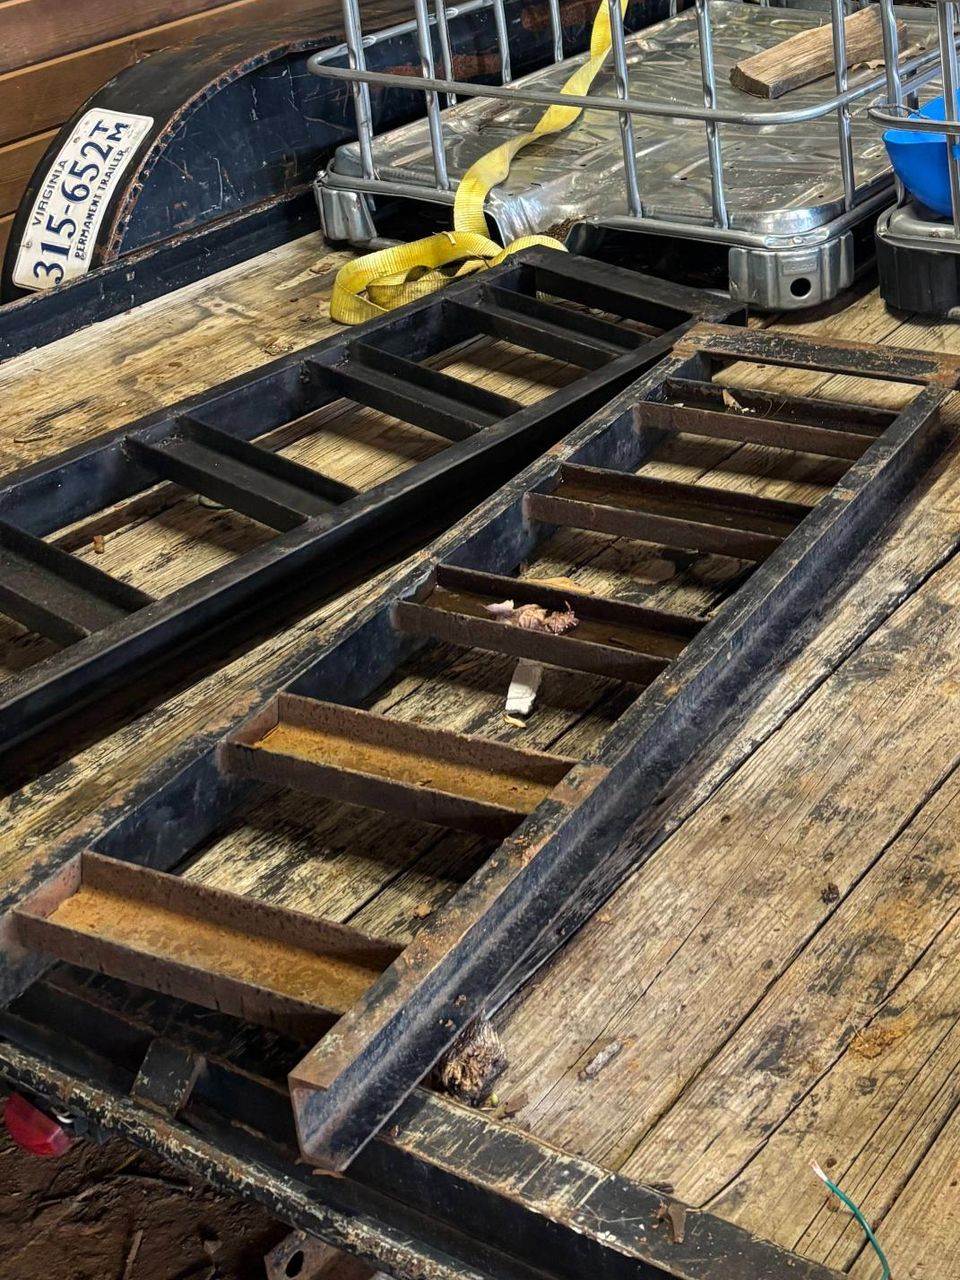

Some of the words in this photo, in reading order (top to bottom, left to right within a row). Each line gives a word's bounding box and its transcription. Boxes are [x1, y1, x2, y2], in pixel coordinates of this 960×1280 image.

[32, 160, 69, 227] VIRGINIA
[32, 141, 115, 285] 315-652
[74, 193, 104, 261] PERMANENT
[98, 149, 128, 194] TRAILER
